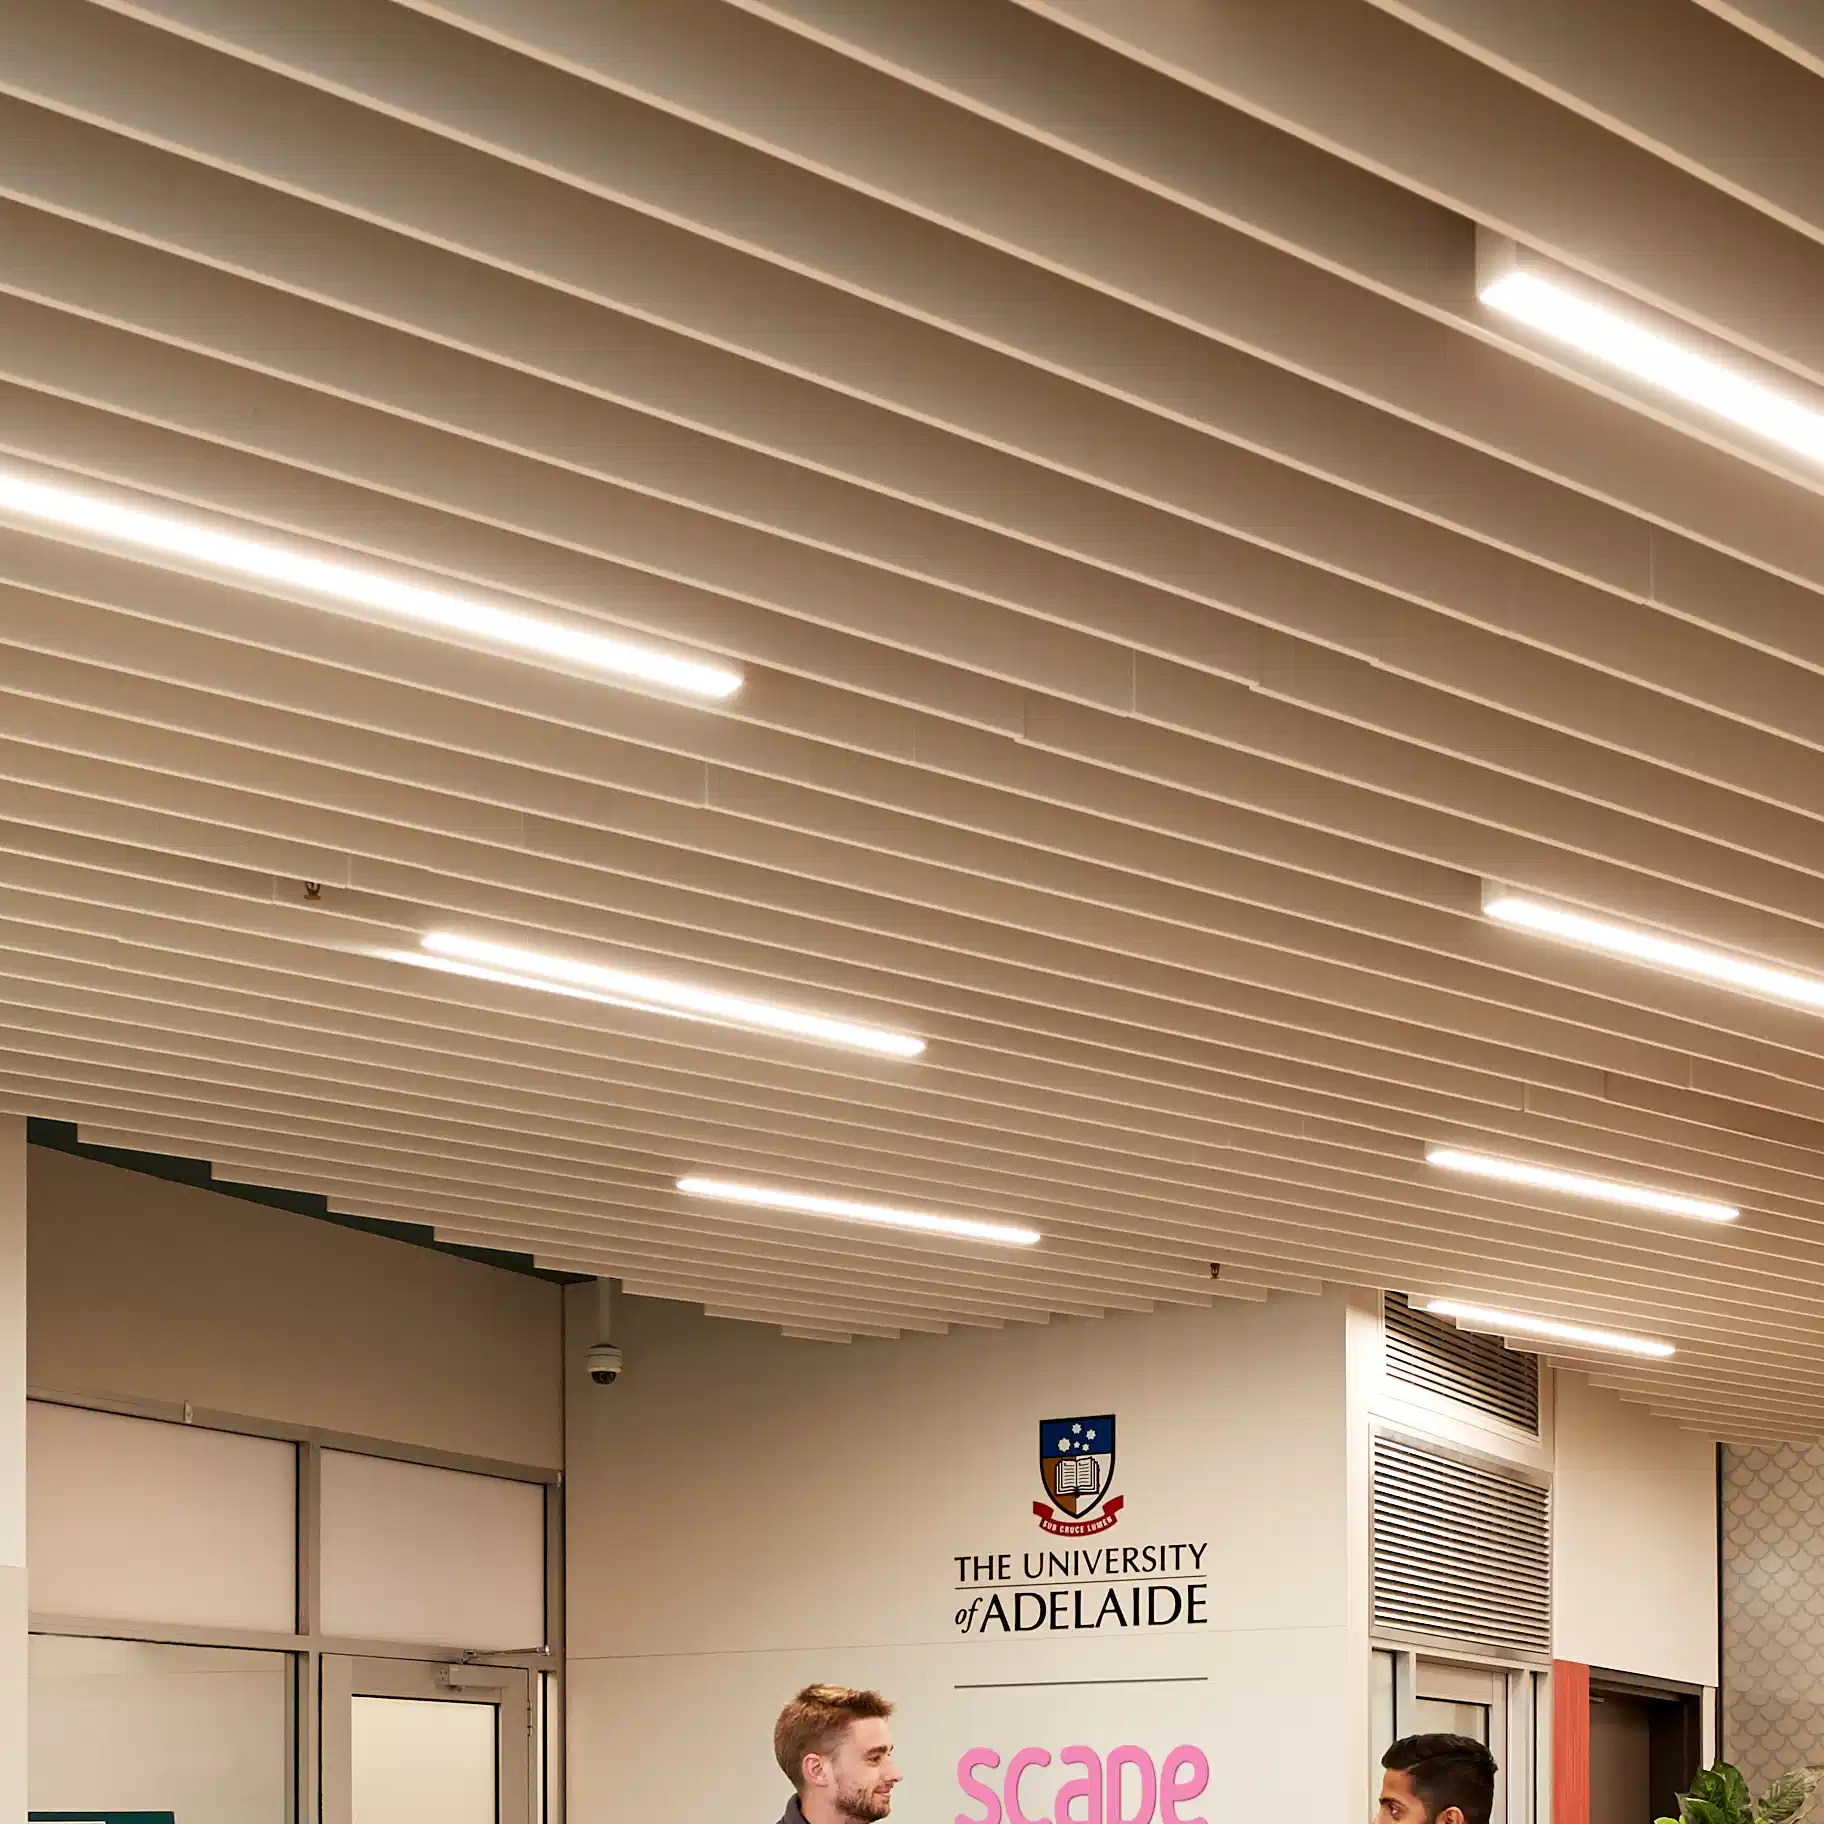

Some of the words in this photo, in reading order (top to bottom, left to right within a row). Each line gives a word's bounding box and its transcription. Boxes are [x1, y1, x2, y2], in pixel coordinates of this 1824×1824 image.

[1042, 1520, 1057, 1532] SUB
[1059, 1525, 1084, 1534] CRUCE
[1087, 1516, 1113, 1532] LUMEN
[954, 1554, 1011, 1582] THE
[1023, 1542, 1208, 1579] UNIVERSITY
[954, 1597, 984, 1634] of
[979, 1583, 1208, 1633] ADELAIDE
